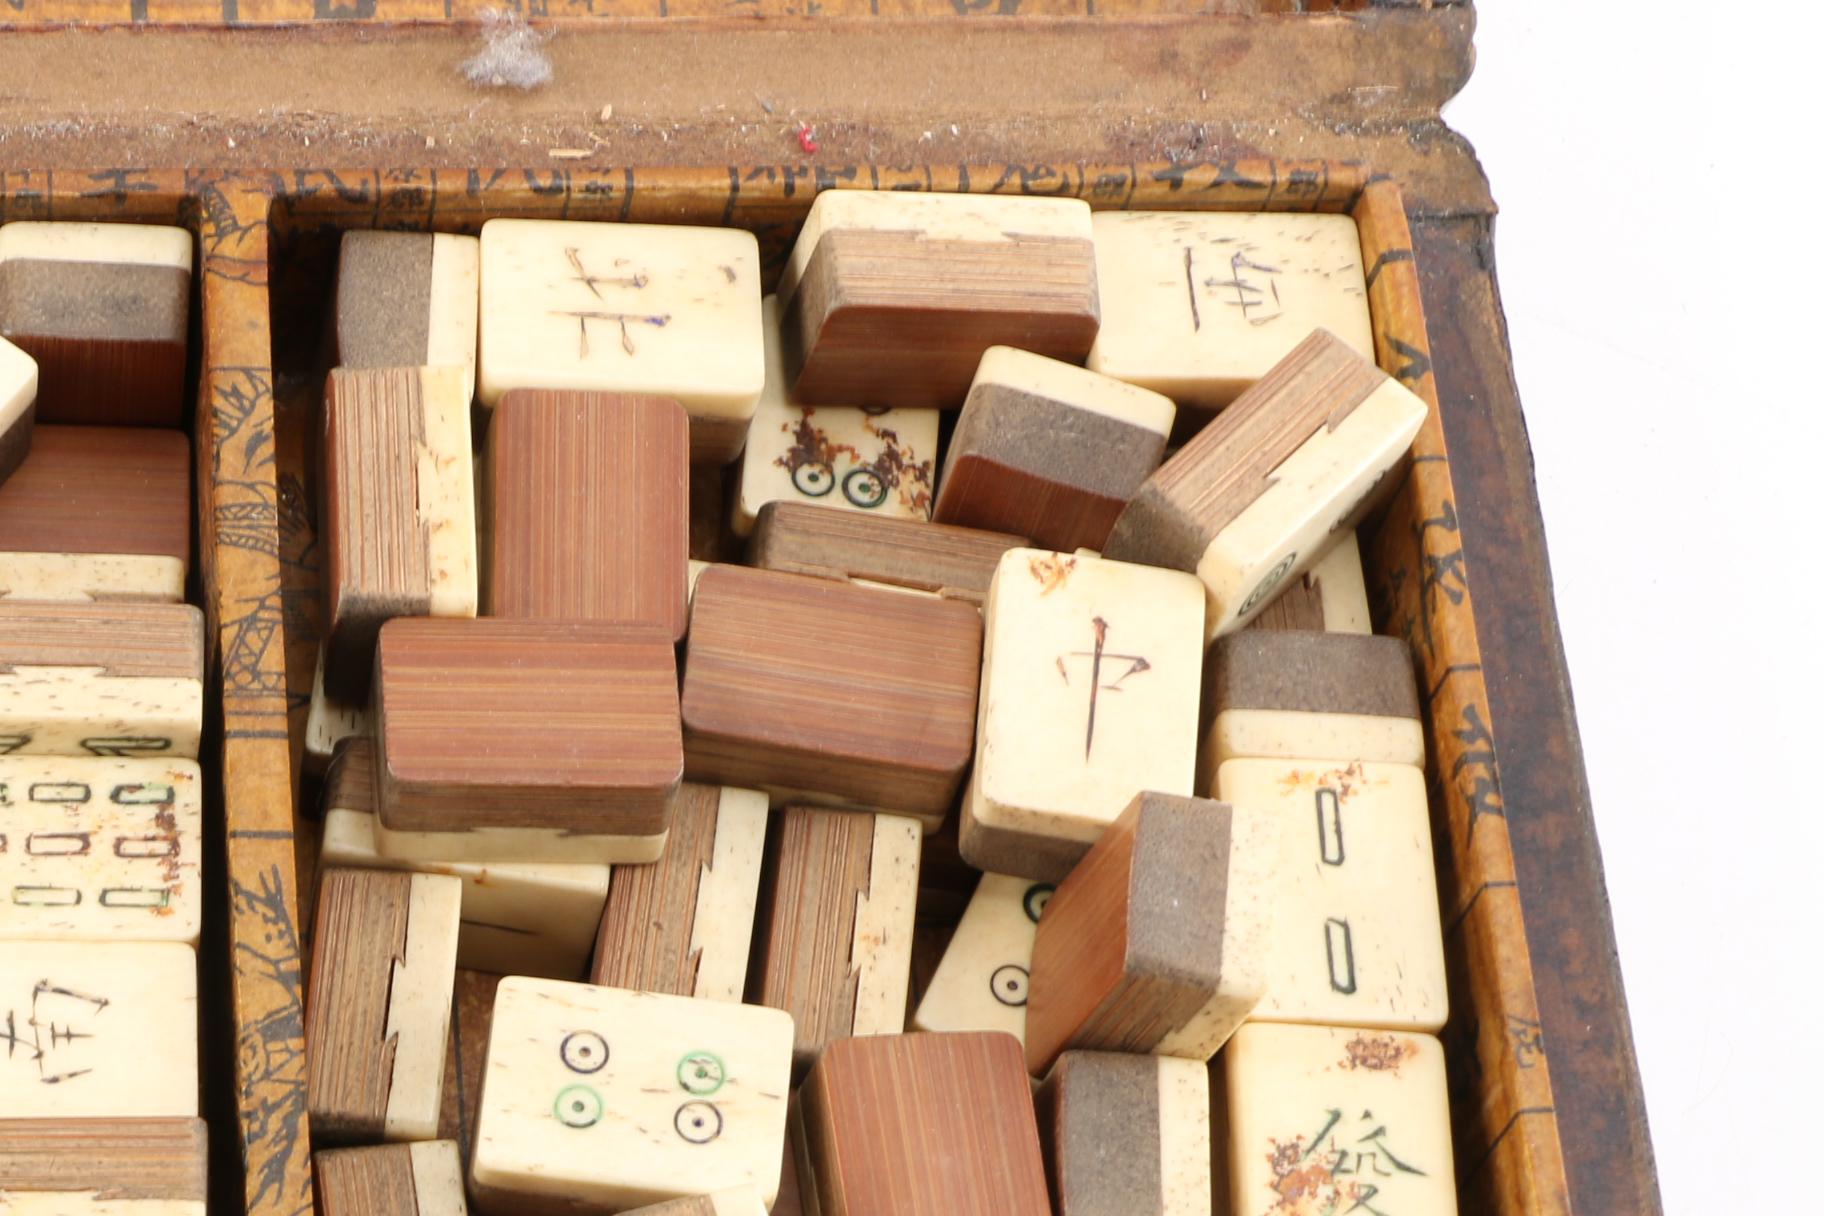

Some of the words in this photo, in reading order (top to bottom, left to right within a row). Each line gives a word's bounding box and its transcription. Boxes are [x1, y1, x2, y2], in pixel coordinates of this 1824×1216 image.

[545, 245, 674, 361] 北
[1182, 245, 1285, 334] 西
[1055, 613, 1153, 765] 中
